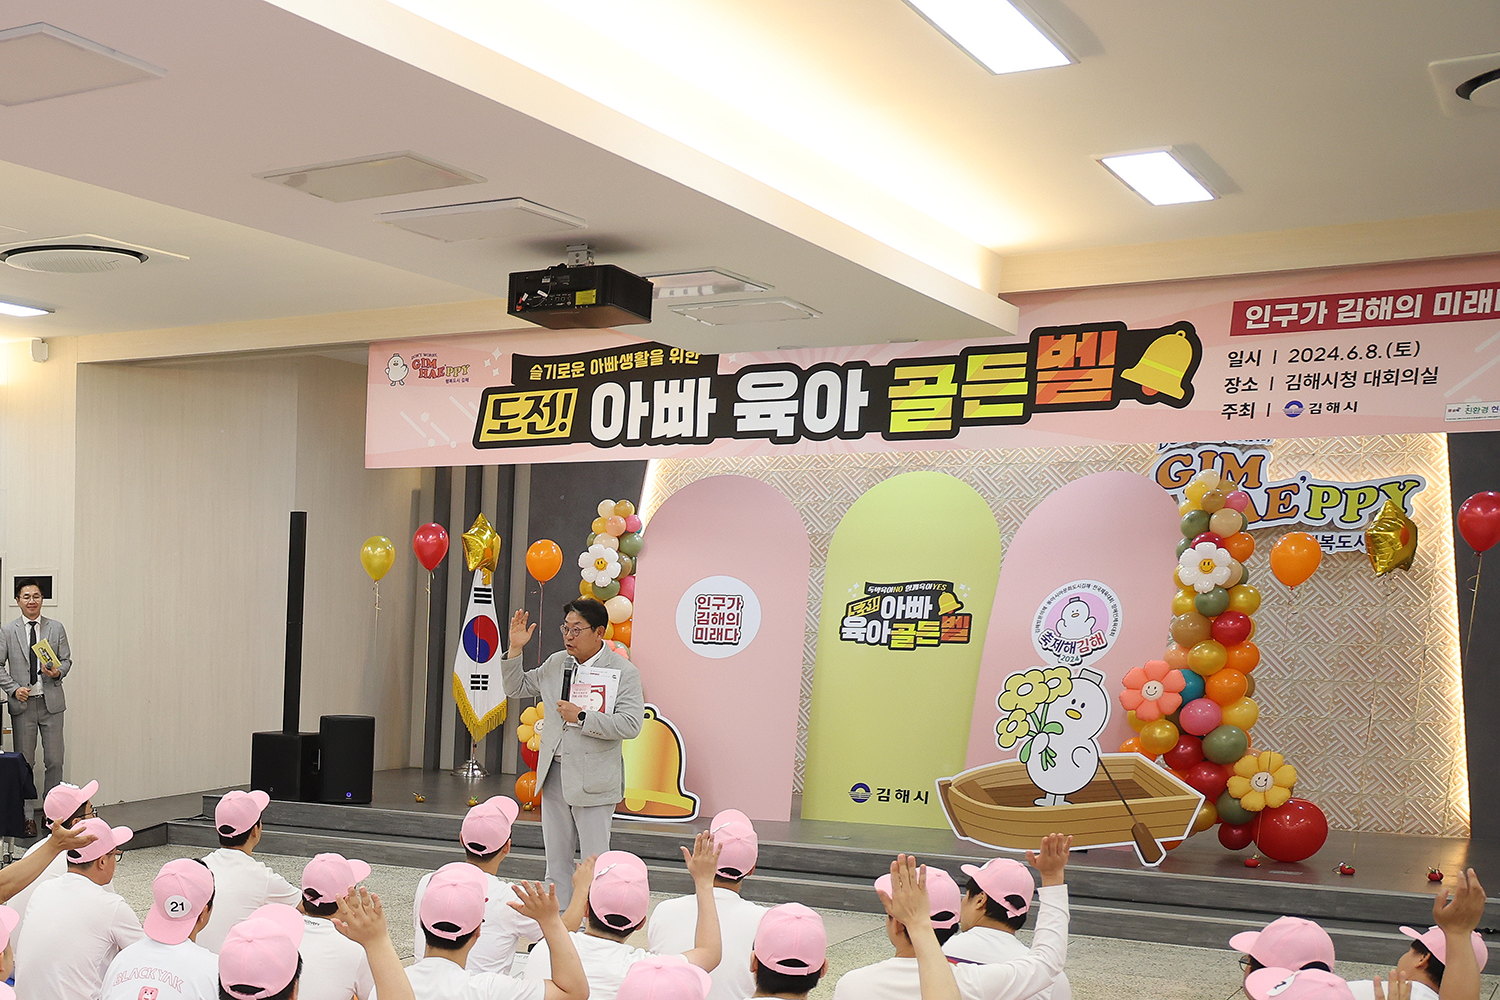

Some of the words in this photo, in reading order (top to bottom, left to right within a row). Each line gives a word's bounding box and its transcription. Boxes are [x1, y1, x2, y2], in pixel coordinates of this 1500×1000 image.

[1245, 301, 1328, 329] 인구가
[1337, 293, 1423, 324] 김해의
[1433, 288, 1500, 316] 미래
[411, 358, 438, 370] GIM
[1227, 350, 1262, 368] 일시
[1287, 340, 1421, 364] 2024.6.8.(토)
[529, 361, 586, 381] 슬기로운
[590, 348, 664, 376] 아빠생활을
[669, 348, 700, 365] 위한
[485, 391, 571, 436] 도전!
[590, 377, 717, 441] 아빠
[734, 368, 869, 437] 육아
[888, 329, 1119, 433] 골든벨
[1224, 377, 1259, 395] 장소
[1285, 371, 1358, 391] 김해시청
[1362, 366, 1440, 388] 대회의실
[1221, 402, 1256, 421] 주최
[1308, 401, 1359, 416] 김해시
[697, 595, 742, 611] 인구가
[850, 596, 880, 614] 도전!
[880, 595, 933, 620] 아빠
[696, 611, 741, 627] 김해의
[694, 626, 740, 642] 미래다
[876, 787, 930, 805] 김해시
[169, 901, 185, 912] 21
